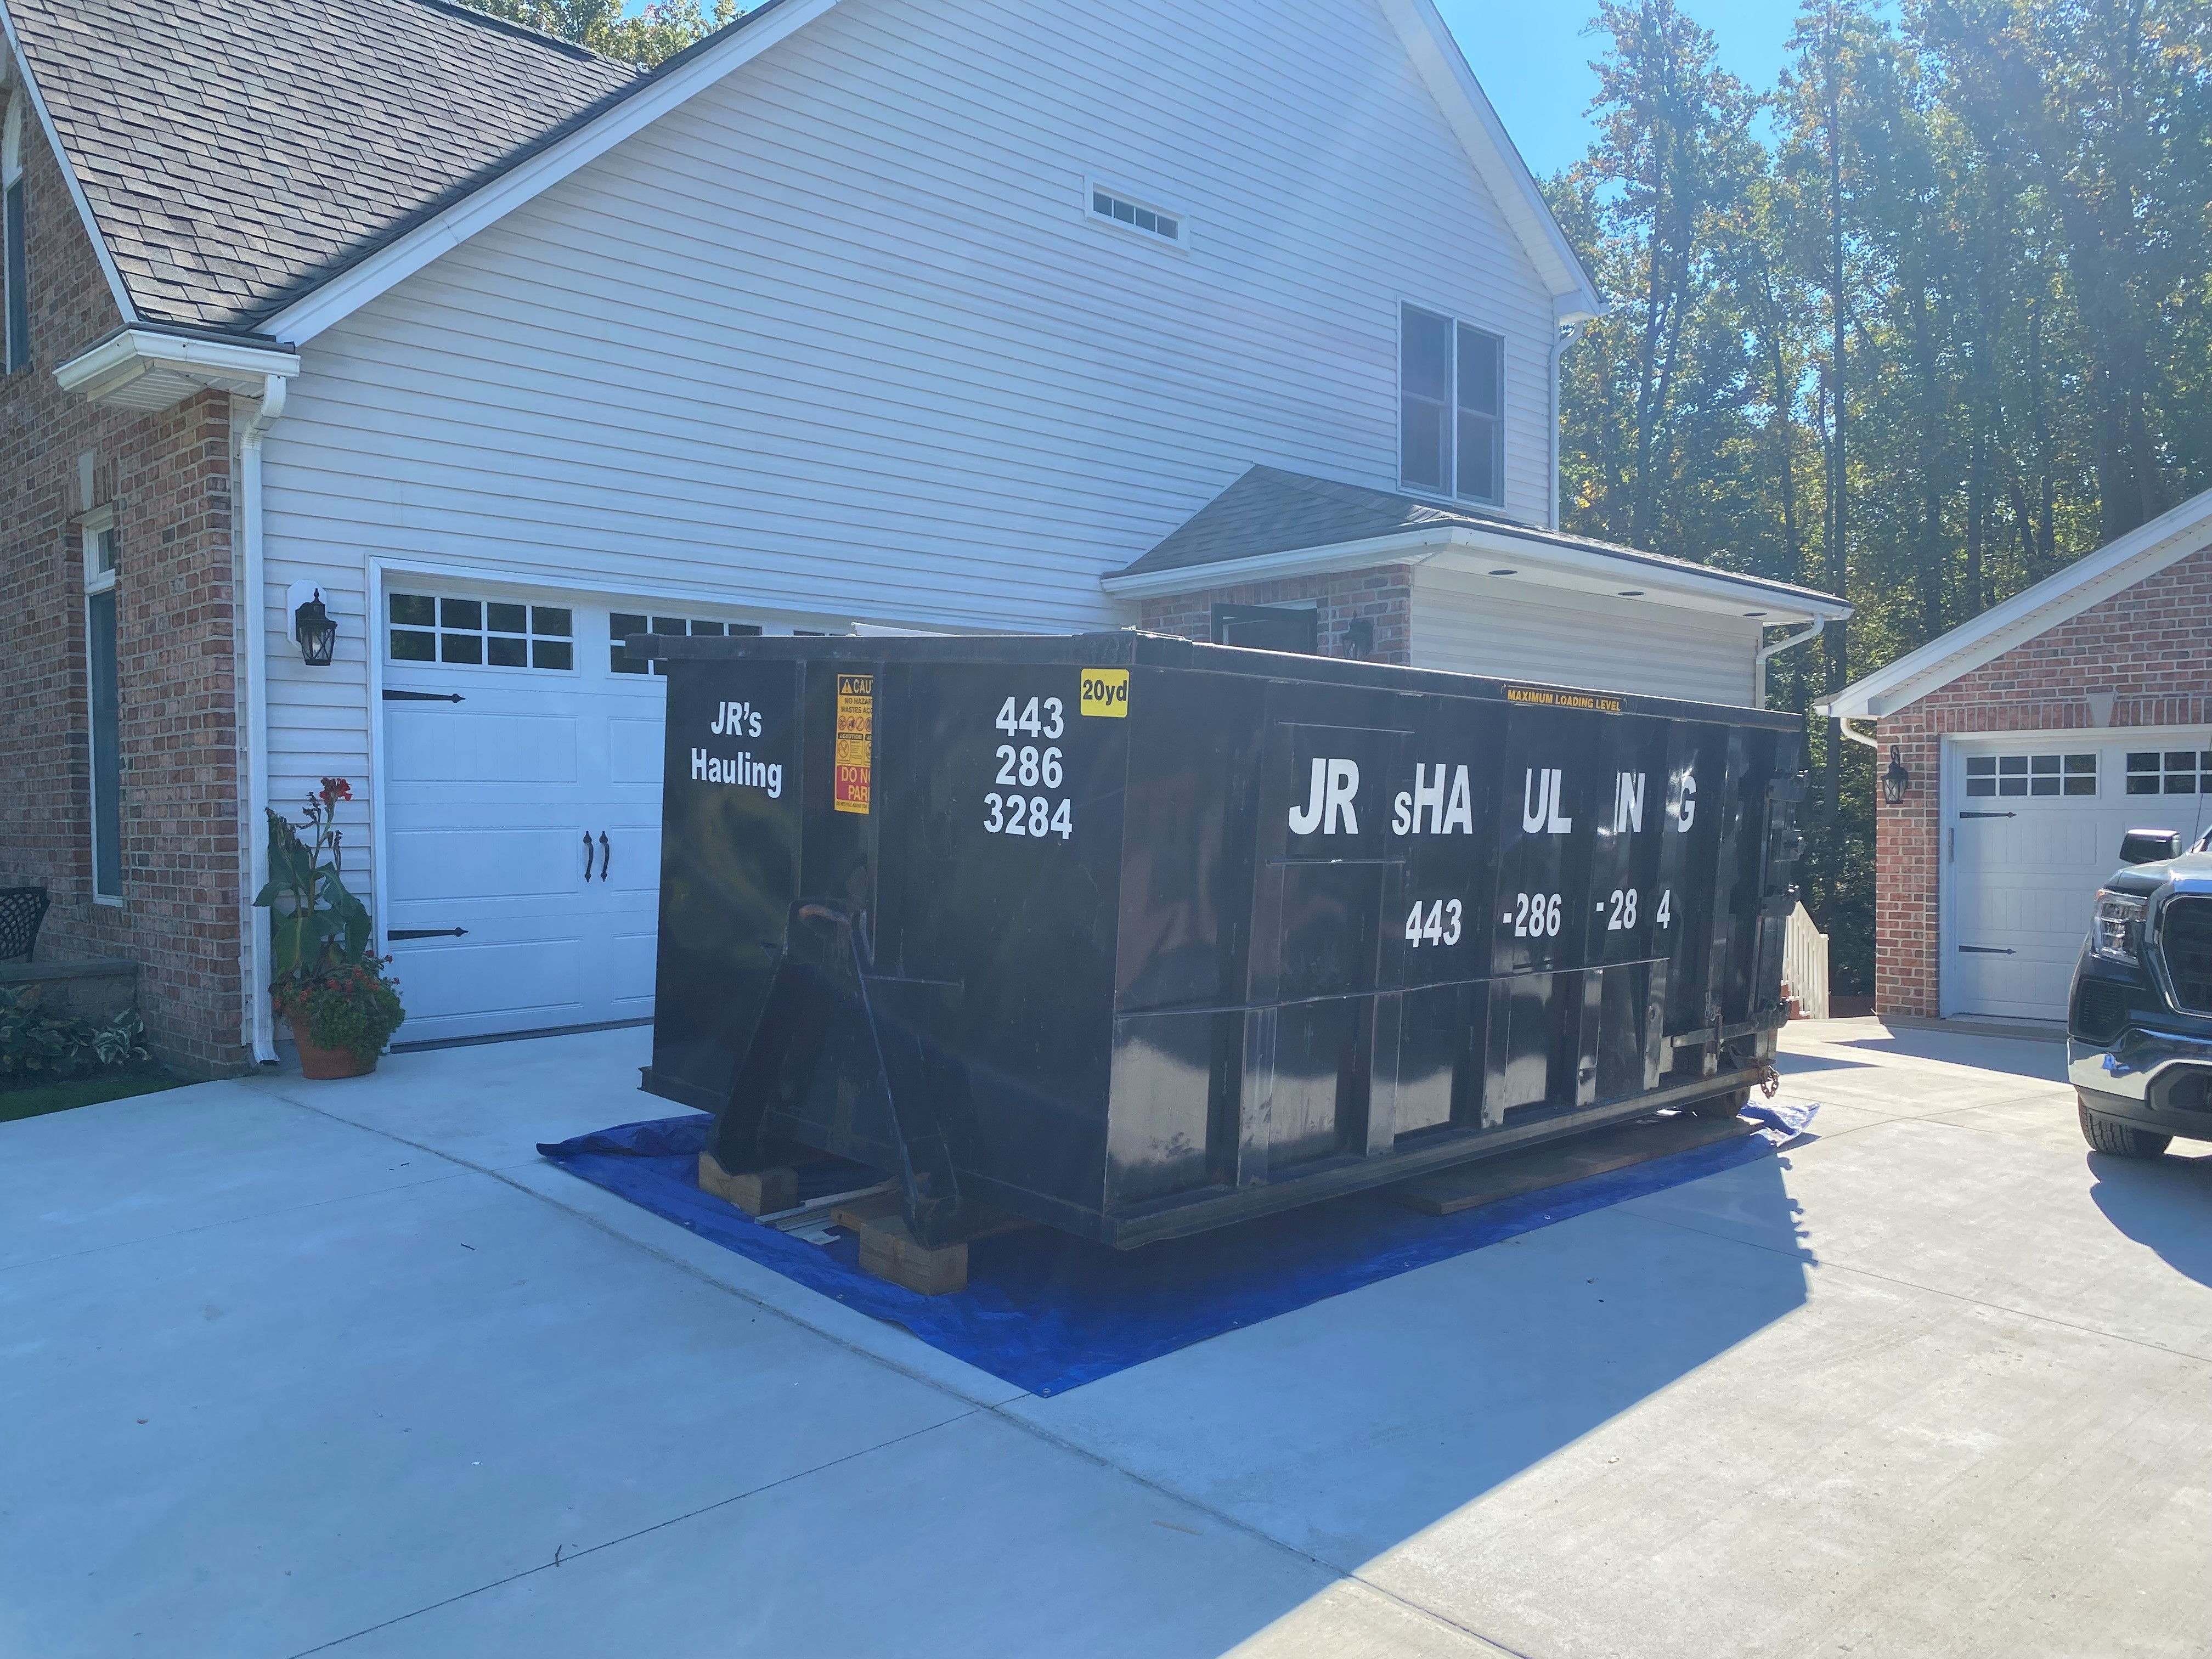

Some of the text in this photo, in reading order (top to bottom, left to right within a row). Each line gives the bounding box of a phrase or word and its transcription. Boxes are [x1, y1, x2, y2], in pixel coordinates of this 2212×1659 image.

[1082, 679, 1127, 706] 20yd
[1508, 690, 1621, 712] MAXIMUM LOADING LEVEL
[710, 701, 762, 738] JR's
[996, 696, 1064, 739] 443
[691, 747, 782, 798] Hauling
[841, 766, 857, 783] DO
[995, 744, 1063, 788] 286
[984, 793, 1073, 839] 3284
[1289, 758, 1359, 835] JR
[1406, 899, 1462, 947] 443
